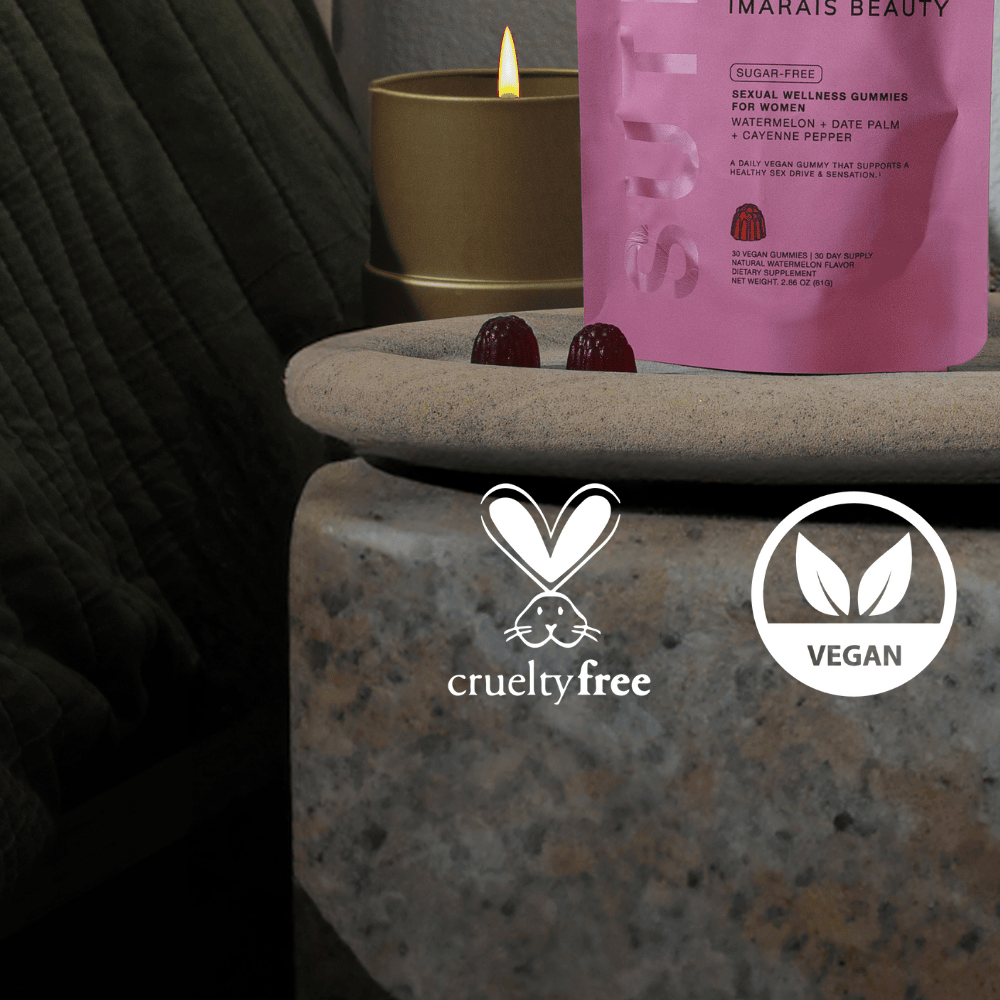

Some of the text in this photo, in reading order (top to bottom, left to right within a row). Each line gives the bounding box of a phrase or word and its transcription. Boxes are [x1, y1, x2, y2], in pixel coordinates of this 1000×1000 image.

[851, 0, 949, 17] BEAUTY
[737, 68, 815, 78] SUGAR-FREE
[732, 90, 908, 101] SEXUAL WELLNESS GUMMIES
[732, 102, 805, 112] FOR WOMEN
[732, 118, 815, 128] WATERMELON
[832, 120, 862, 129] DATE
[868, 120, 899, 129] PALM
[743, 131, 799, 140] CAYENNE
[804, 132, 851, 141] PEPPER
[764, 269, 816, 277] SUPPLEMENT
